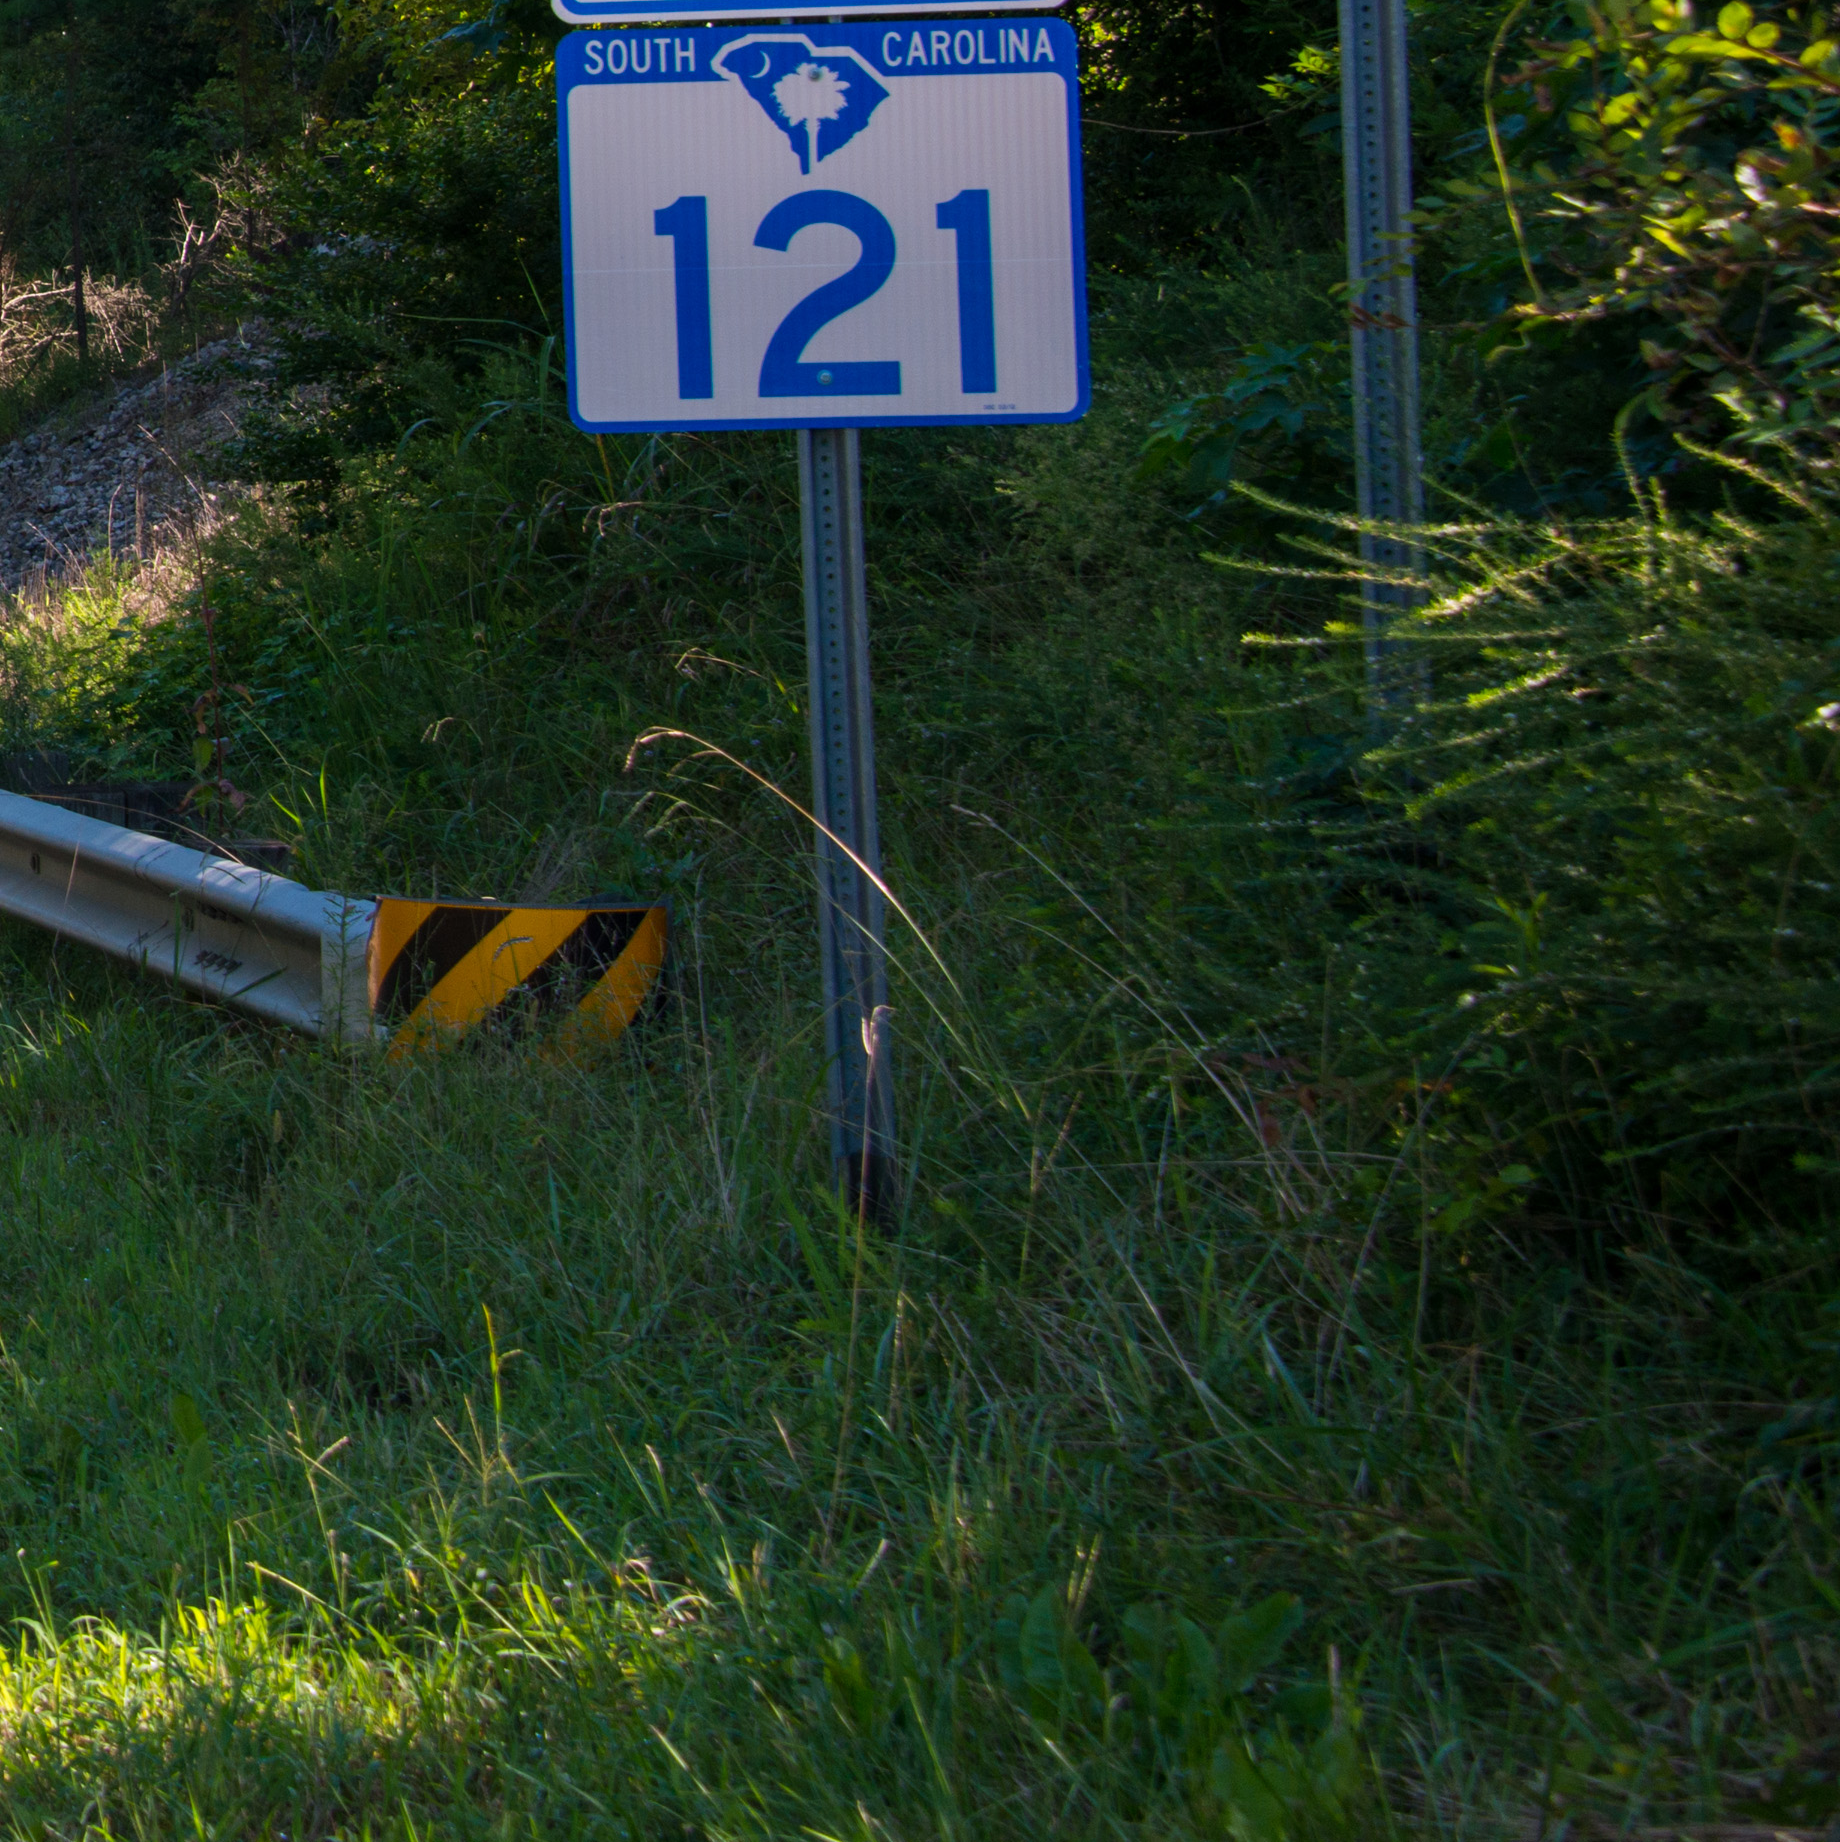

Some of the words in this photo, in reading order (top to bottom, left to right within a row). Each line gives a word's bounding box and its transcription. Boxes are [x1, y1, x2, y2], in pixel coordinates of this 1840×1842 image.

[583, 38, 696, 75] SOUTH
[882, 28, 1056, 67] CAROLINA
[653, 188, 998, 400] 121
